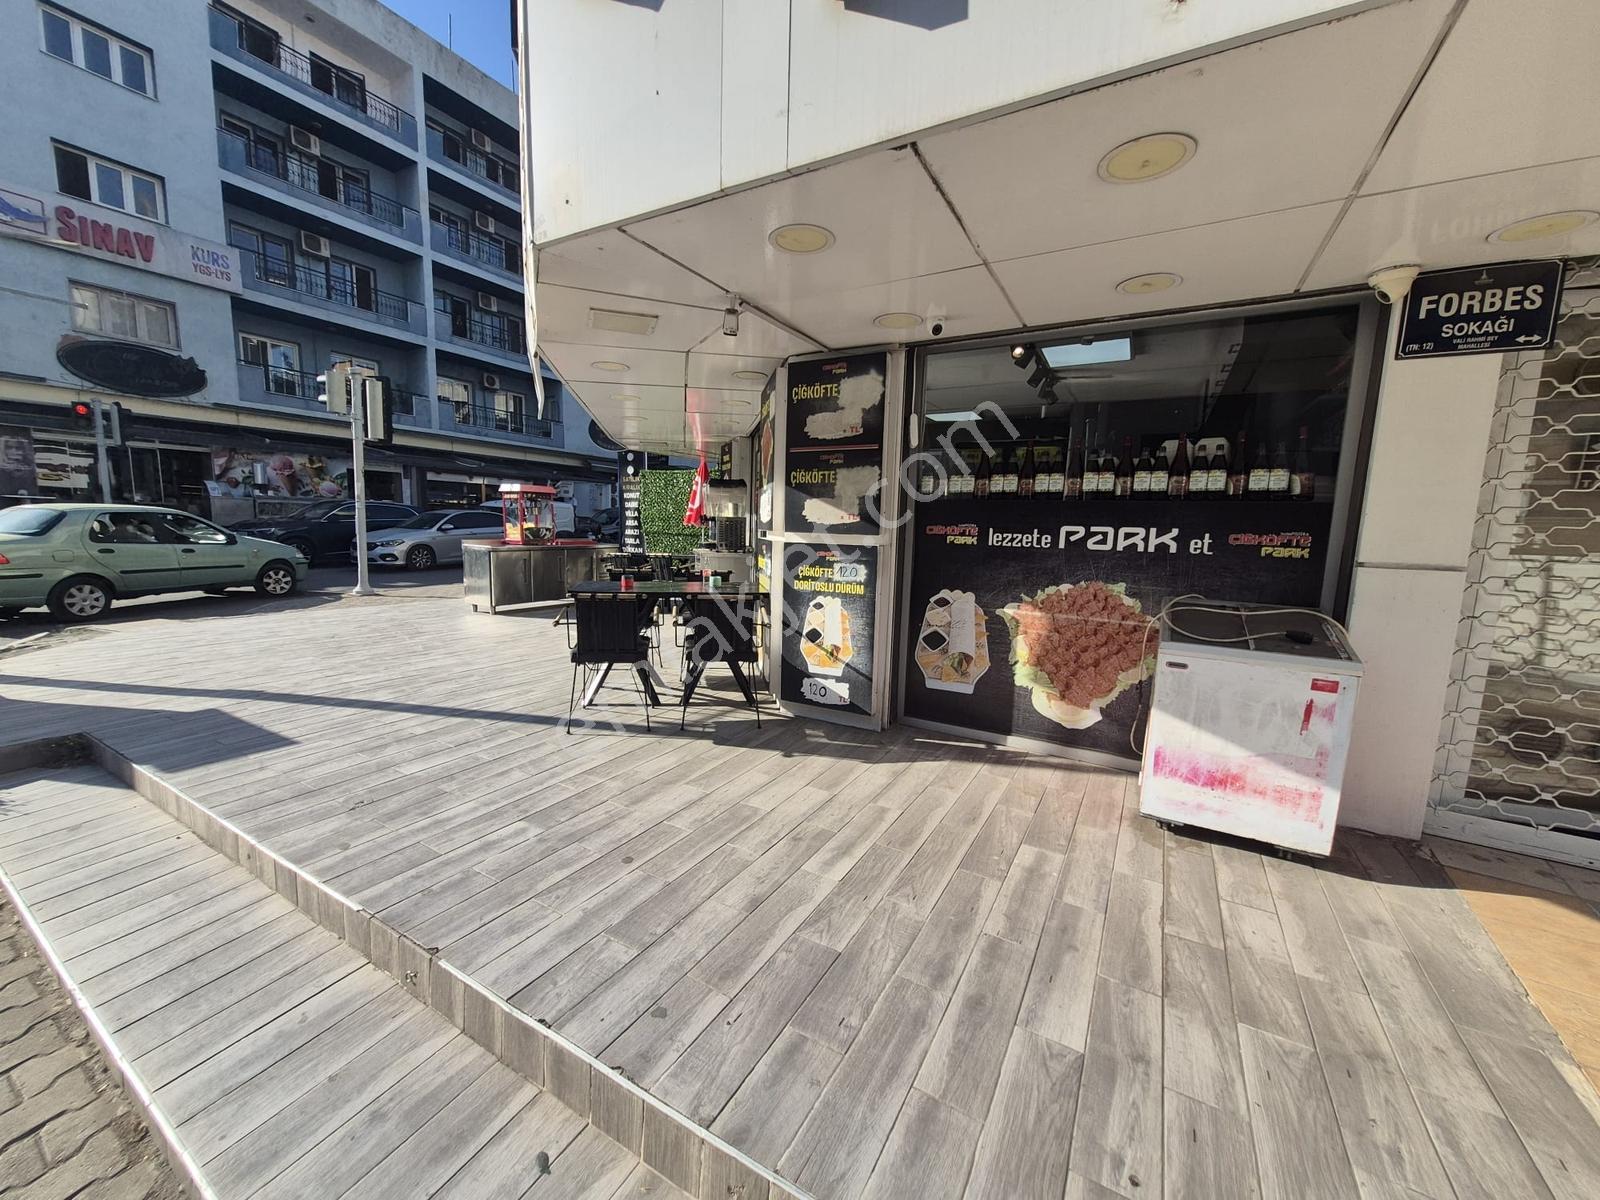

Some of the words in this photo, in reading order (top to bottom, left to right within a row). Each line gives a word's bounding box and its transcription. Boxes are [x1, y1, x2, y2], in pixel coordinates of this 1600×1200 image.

[55, 205, 155, 263] SINAV
[190, 245, 230, 270] KURS
[192, 263, 232, 282] YGS-LYS
[1418, 284, 1544, 320] FORBES
[1441, 314, 1515, 338] SOKAĞI
[792, 382, 838, 404] ÇİĞKÖFTE
[790, 469, 835, 488] ÇİĞKÖFTE
[988, 528, 1051, 548] lezzete
[1189, 533, 1214, 555] et
[798, 564, 833, 578] ÇİĞKÖFTE
[836, 566, 858, 578] 120
[793, 579, 834, 592] DORİTOSLU
[835, 581, 865, 595] DÜRÜM
[809, 682, 827, 698] 120
